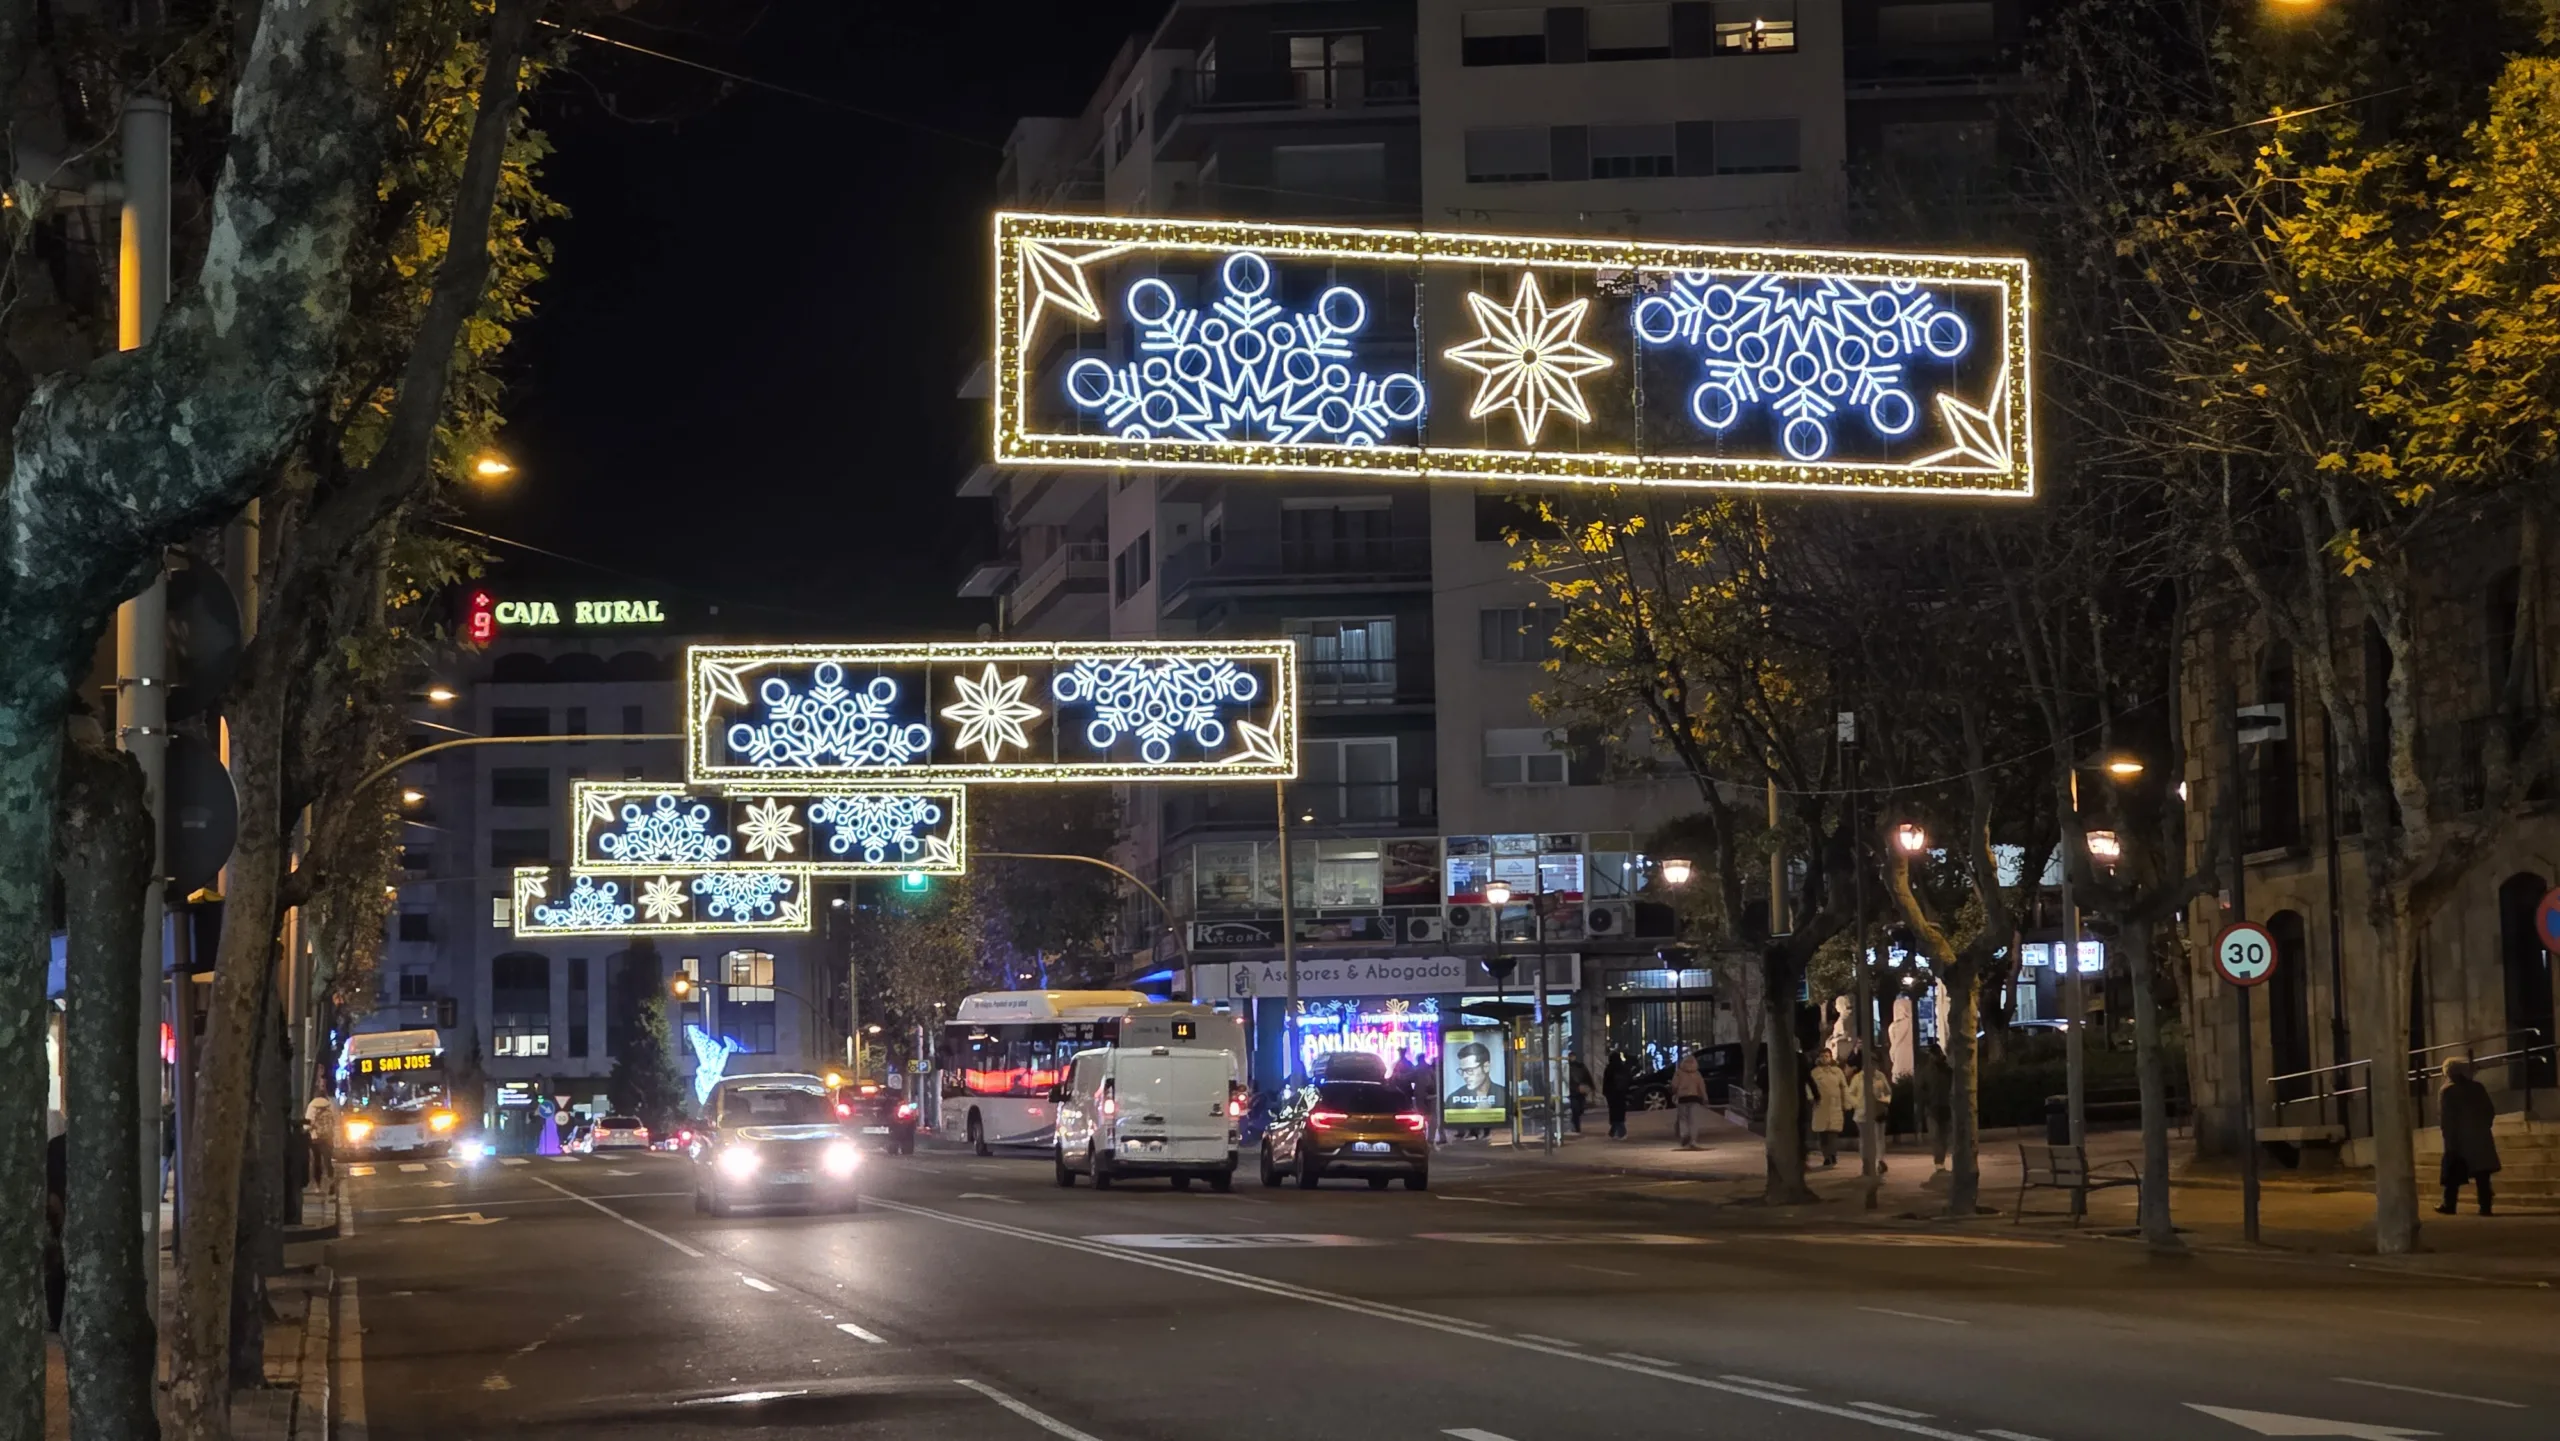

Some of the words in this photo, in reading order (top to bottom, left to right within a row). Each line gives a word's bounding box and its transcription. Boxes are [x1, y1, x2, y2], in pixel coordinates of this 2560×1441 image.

[495, 601, 560, 625] CAJA
[575, 600, 664, 624] RURAL
[2228, 943, 2264, 965] 30
[1347, 965, 1358, 979] &
[1366, 963, 1461, 981] Abogados
[361, 1059, 372, 1073] 13
[380, 1057, 401, 1072] SAN
[404, 1055, 431, 1069] JOSE
[1452, 1095, 1495, 1104] POLICE
